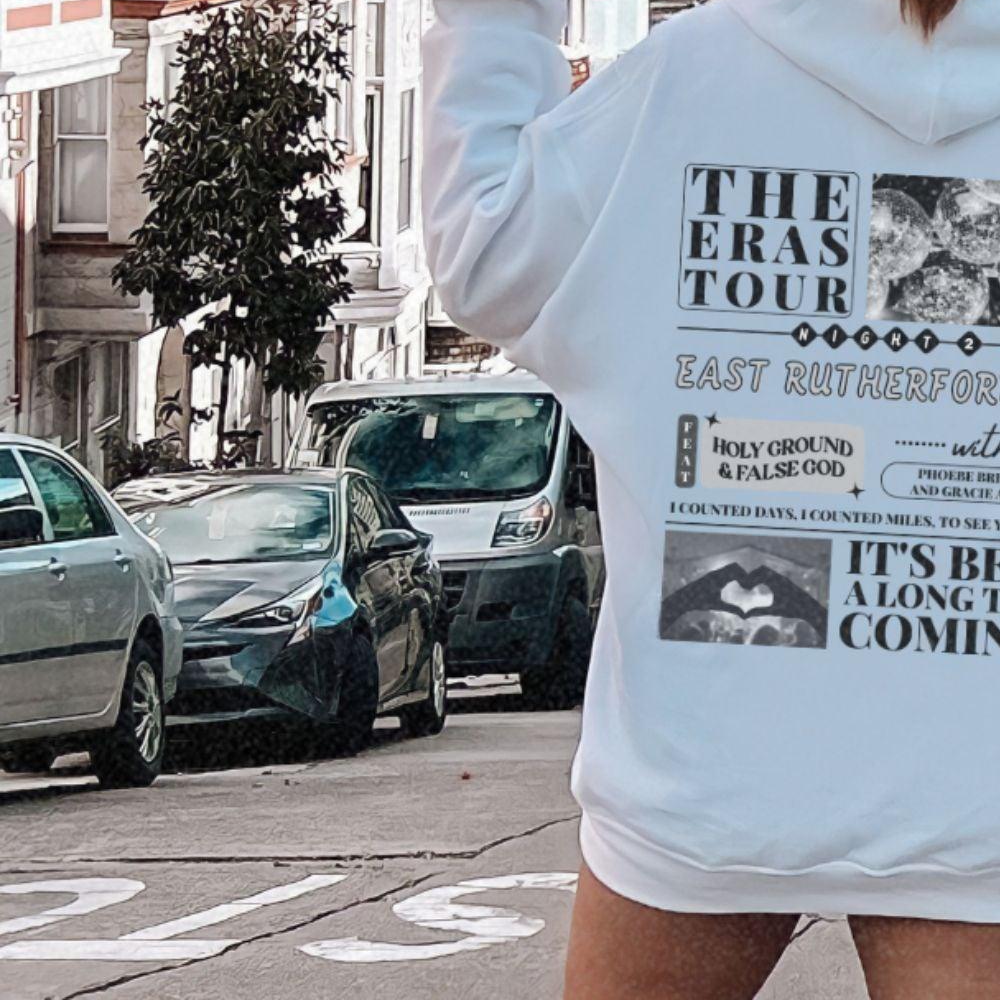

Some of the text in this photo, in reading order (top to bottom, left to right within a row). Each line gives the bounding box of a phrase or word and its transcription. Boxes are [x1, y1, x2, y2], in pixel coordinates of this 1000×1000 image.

[691, 167, 850, 222] THE
[686, 220, 849, 268] ERAS
[684, 269, 850, 314] TOUR
[796, 325, 934, 351] NIGHT
[675, 354, 771, 393] EAST
[681, 421, 694, 483] FEAT
[712, 436, 854, 459] HOLY GROUND
[718, 458, 845, 482] & FALSE GOD
[917, 468, 975, 483] PHOEBE
[909, 485, 939, 496] AND
[941, 486, 993, 500] GRACIE
[679, 502, 752, 518] COUNTED
[810, 508, 883, 525] COUNTED
[939, 516, 961, 529] TO
[963, 517, 991, 531] SEE
[846, 540, 936, 579] IT'S
[843, 580, 869, 607] A
[876, 582, 975, 612] LONG
